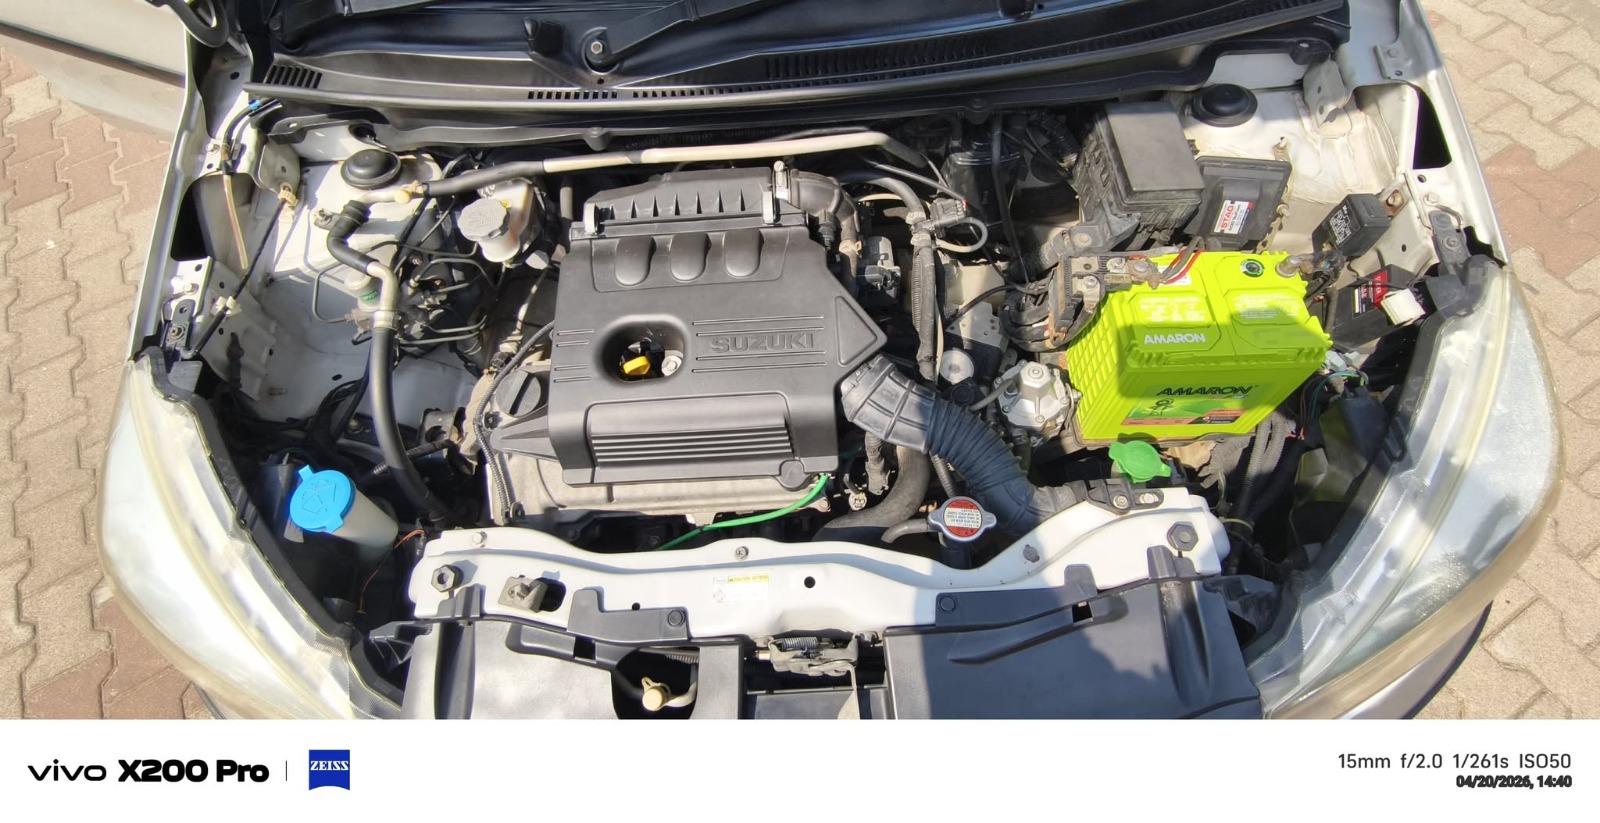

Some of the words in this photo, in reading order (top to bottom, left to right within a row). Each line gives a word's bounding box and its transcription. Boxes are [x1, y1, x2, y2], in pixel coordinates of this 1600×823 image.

[1220, 204, 1234, 229] STAG
[710, 333, 814, 353] SUZUKI
[1144, 333, 1207, 345] AMARON
[1156, 385, 1254, 397] AMARON
